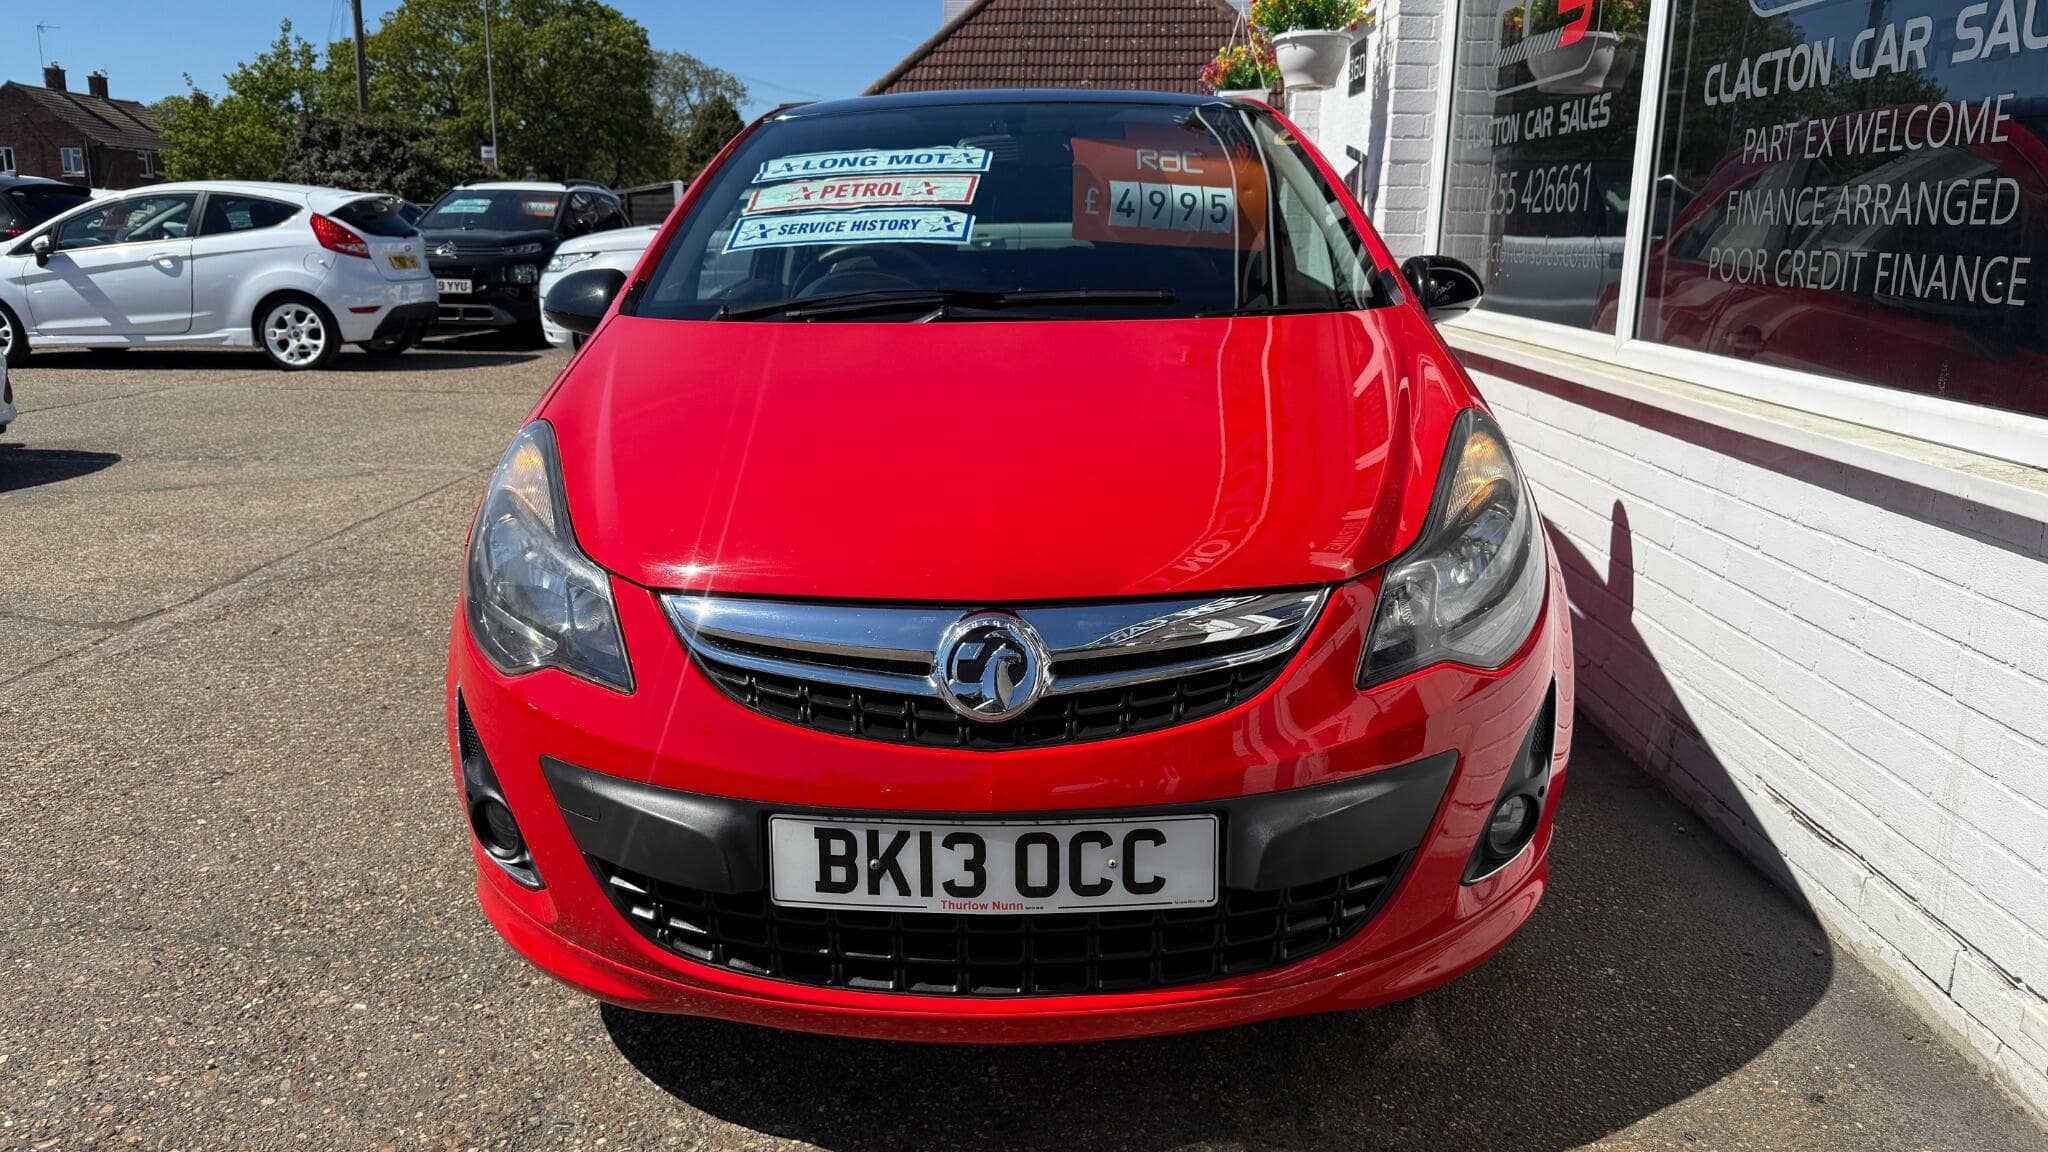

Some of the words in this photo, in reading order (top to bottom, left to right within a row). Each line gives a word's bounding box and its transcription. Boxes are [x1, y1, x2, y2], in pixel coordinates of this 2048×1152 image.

[1704, 37, 1836, 106] CLACTON
[1850, 16, 1934, 80] CAR
[1524, 105, 1554, 140] CAR
[1558, 92, 1612, 135] SALES
[1742, 122, 1799, 165] PART
[1803, 117, 1837, 160] EX
[1845, 93, 2015, 156] WELCOME
[802, 156, 878, 171] LONG
[888, 153, 950, 166] MOT
[819, 181, 903, 199] PETROL
[1116, 188, 1228, 224] 4995
[1521, 161, 1592, 214] 426661
[1726, 186, 1828, 226] FINANCE
[1832, 177, 2021, 226] ARRANGED
[778, 220, 847, 235] SERVICE
[851, 218, 921, 232] HISTORY
[1707, 247, 1768, 285] POOR
[1775, 249, 1868, 293] CREDIT
[1874, 252, 2032, 307] FINANCE
[813, 827, 987, 898] BK13
[1015, 828, 1167, 898] OCC
[941, 900, 988, 911] Thurlow
[992, 901, 1024, 911] Nunn
